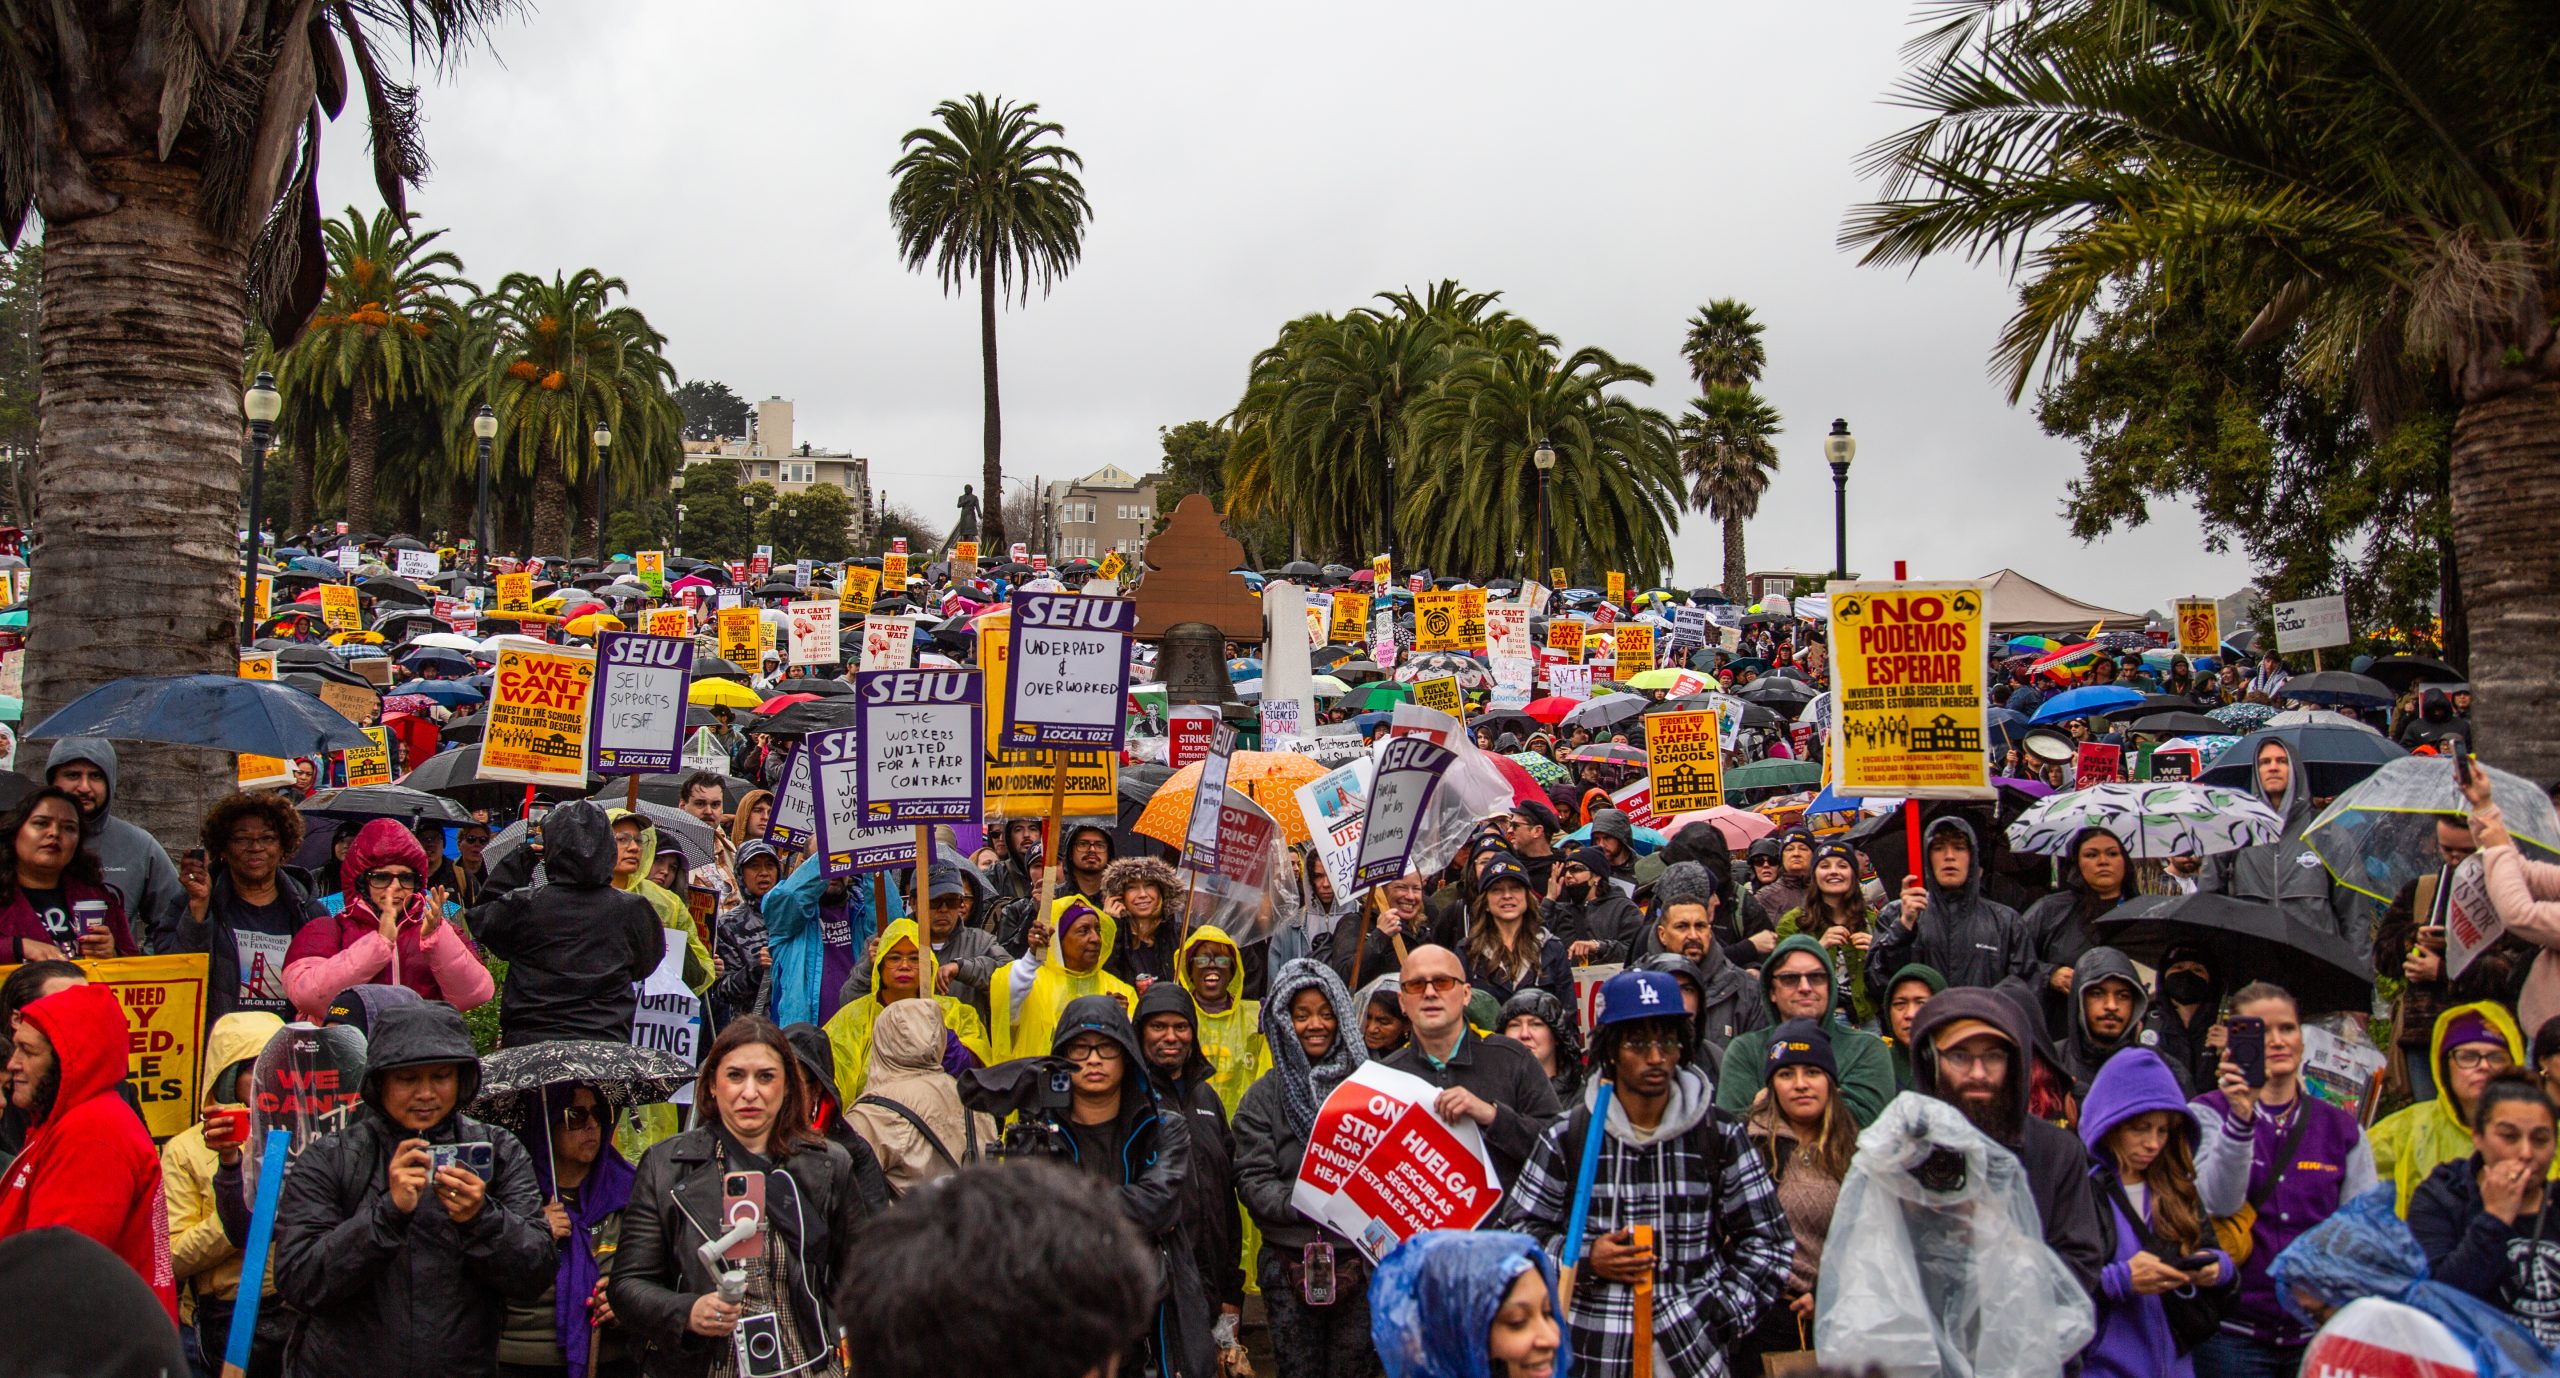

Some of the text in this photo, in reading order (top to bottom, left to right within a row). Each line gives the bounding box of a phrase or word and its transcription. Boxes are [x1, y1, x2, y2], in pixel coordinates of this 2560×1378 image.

[1022, 596, 1123, 628] SEIU
[1501, 609, 1525, 617] CAN'T
[1872, 597, 1944, 624] NO
[657, 615, 676, 623] WE
[2276, 618, 2306, 632] FAIRLY
[884, 624, 909, 632] CAN'T
[1432, 621, 1445, 632] UP
[1675, 627, 1703, 636] STRIKING
[887, 631, 908, 639] WAIT
[1551, 638, 1580, 646] WAIT
[1860, 622, 1967, 654] PODEMOS
[609, 637, 684, 666] SEIU
[1025, 638, 1105, 656] UNDERPAID
[524, 659, 574, 680] WE
[1555, 668, 1588, 684] WTF
[1866, 654, 1961, 685] ESPERAR
[500, 671, 588, 697] CAN'T
[615, 672, 655, 690] SEIU
[868, 672, 968, 704] SEIU
[1024, 680, 1119, 697] OVERWORKED
[1424, 687, 1448, 695] FULLY
[1848, 685, 1974, 699] INVIERTA EN LAS ESCUELAS QUE
[501, 687, 582, 711] WAIT
[610, 692, 670, 709] SUPPORTS
[1418, 692, 1457, 702] STAFFED,
[1843, 696, 1980, 711] NUESTROS ESTUDIANTES MERECEN
[494, 703, 582, 725] INVEST IN THE SCHOOLS
[896, 712, 937, 724] THE
[1265, 711, 1298, 719] SILENCED
[1659, 715, 1704, 726] STUDENTS NEED
[493, 713, 582, 735] OUR STUDENTS DESERVE
[1187, 721, 1202, 730] ON
[1263, 720, 1296, 734] HONK!
[1660, 723, 1702, 734] FULLY
[886, 729, 954, 742] WORKERS
[1012, 734, 1036, 742] SEIU
[1042, 729, 1113, 742] LOCAL 1021
[1179, 735, 1210, 744] STRIKE
[1652, 732, 1713, 745] STAFFED,
[349, 745, 380, 755] STABLE
[884, 741, 946, 759] UNITED
[1289, 738, 1363, 753] When Teachers are
[1656, 742, 1706, 754] STABLE
[348, 751, 386, 761] SCHOOLS
[619, 755, 671, 765] LOCAL 1021
[687, 756, 713, 766] THIS IS
[1381, 741, 1446, 773] SEIU
[1654, 751, 1715, 764] SCHOOLS
[2084, 756, 2113, 764] FULLY
[877, 755, 963, 773] FOR A FAIR
[2083, 765, 2113, 773] STAFF
[2160, 767, 2182, 775] WE
[891, 774, 963, 788] CONTRACT
[988, 774, 1107, 791] NO PODEMOS SPERAR
[1630, 796, 1643, 807] ON
[1656, 796, 1718, 811] WE CAN'T WAIT!
[868, 813, 891, 821] SEIU
[897, 804, 970, 816] LOCAL 1021
[1222, 809, 1248, 826] ON
[771, 833, 787, 844] SEIU
[857, 854, 895, 865] LOCAL
[1204, 853, 1215, 865] 1021
[830, 863, 852, 873] SEIU
[1366, 863, 1400, 879] LOCAL 1021
[2454, 881, 2472, 901] IS
[2464, 901, 2496, 934] FOR
[251, 933, 288, 945] EDUCATORS
[250, 941, 286, 953] FRANCISCO
[124, 987, 166, 1006] NEED
[1637, 978, 1660, 1005] LA
[1788, 1042, 1810, 1051] UESF
[275, 1068, 340, 1090] WE
[256, 1092, 362, 1115] CAN'T
[1368, 1094, 1404, 1124] ON
[1332, 1133, 1362, 1157] FOR
[1310, 1142, 1360, 1172] FUNDE
[1400, 1128, 1478, 1209] HUELGA
[2297, 1161, 2321, 1170] SEIU
[1357, 1164, 1408, 1217] ESTABLES
[1394, 1160, 1455, 1217] ¡ESCUELAS
[1383, 1169, 1444, 1228] SEGURAS Y
